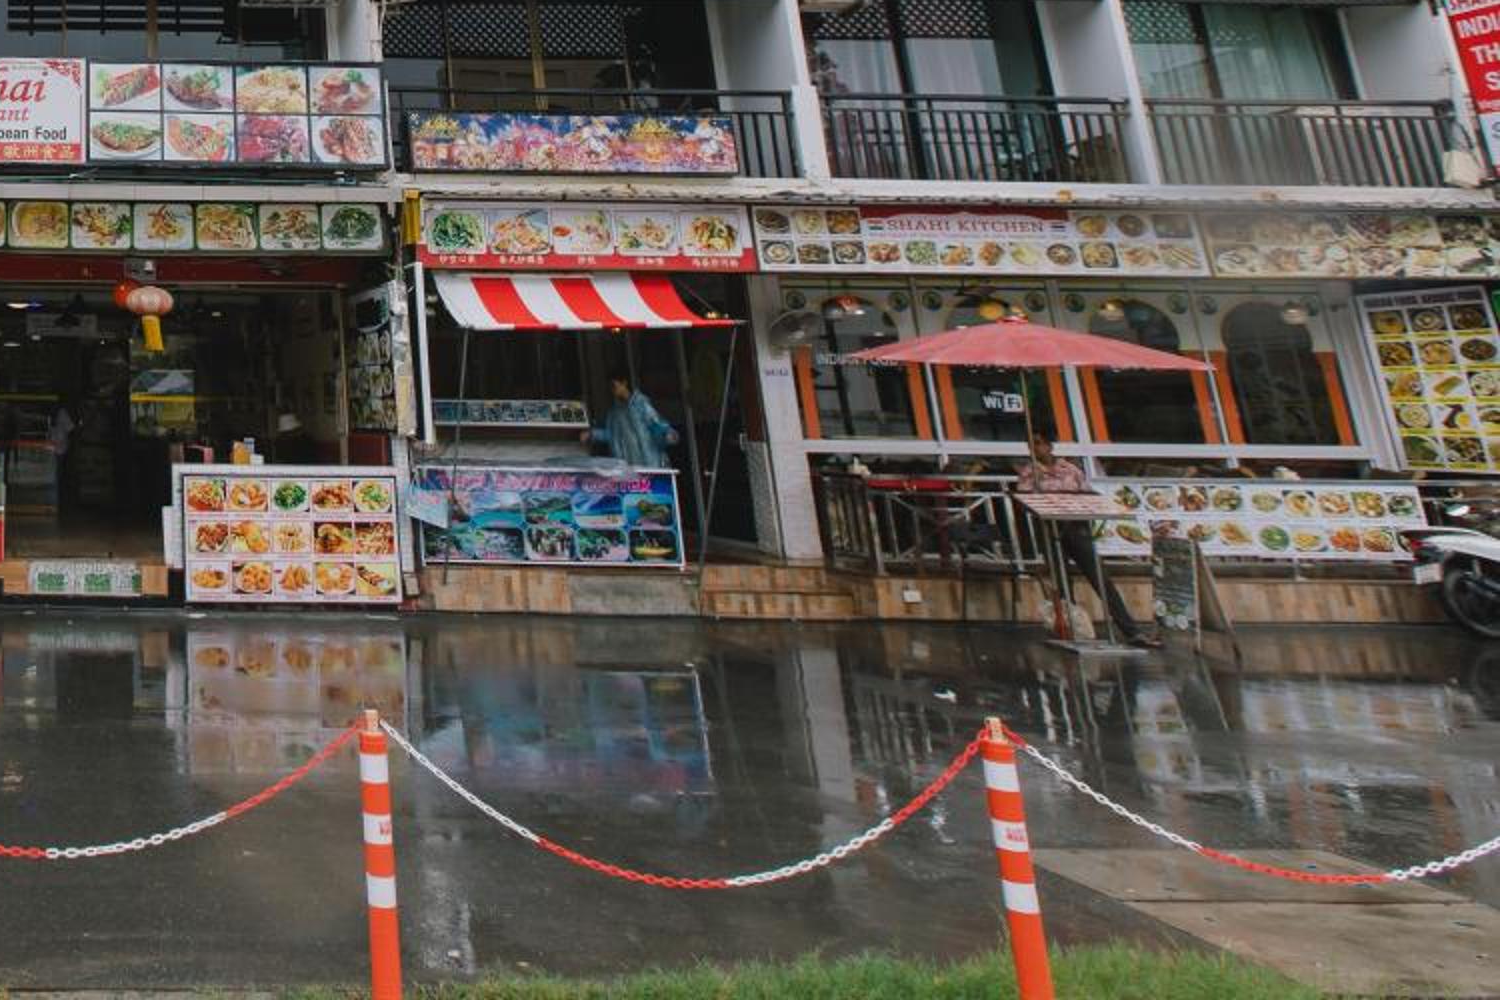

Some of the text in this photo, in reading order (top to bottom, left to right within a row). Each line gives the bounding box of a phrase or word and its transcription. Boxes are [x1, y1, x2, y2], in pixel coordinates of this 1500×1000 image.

[1457, 12, 1500, 38] INDI
[35, 126, 67, 140] Food
[887, 220, 1044, 233] SHAHI KITCHEN
